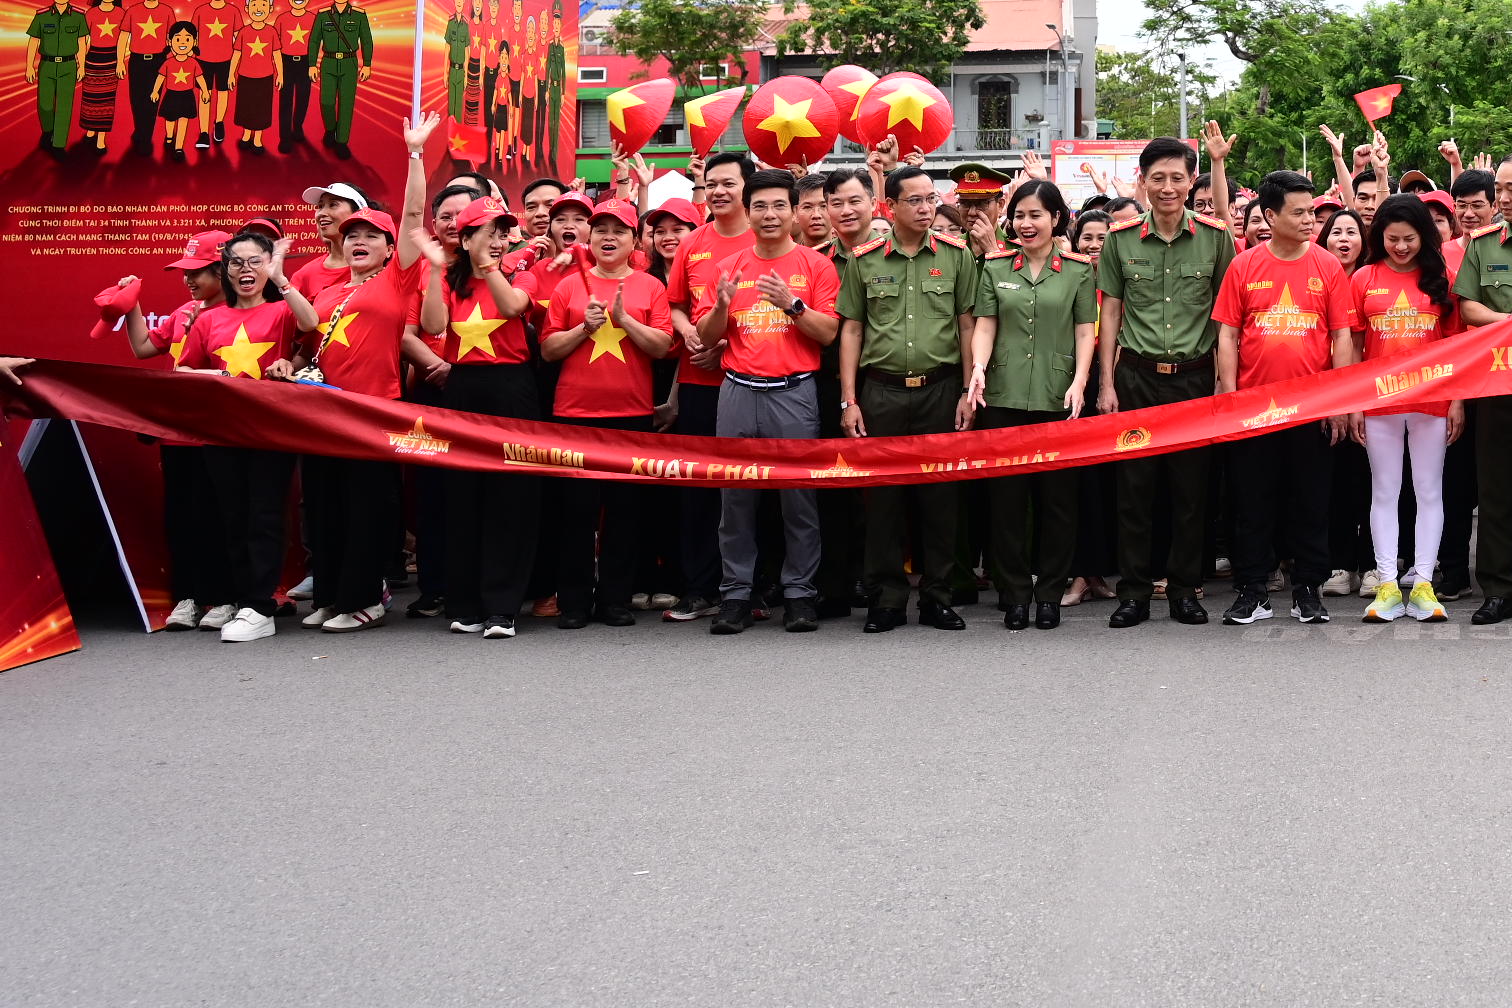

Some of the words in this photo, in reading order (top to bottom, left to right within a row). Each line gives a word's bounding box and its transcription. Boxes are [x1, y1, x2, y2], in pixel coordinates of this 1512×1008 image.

[8, 205, 42, 213] CHƯƠNG
[44, 204, 67, 213] TRÌNH
[126, 203, 148, 212] NHÂN
[151, 203, 167, 212] DÂN
[271, 204, 282, 212] AN
[152, 247, 164, 255] AN
[1287, 314, 1318, 330] NAM
[1404, 316, 1437, 331] NAM
[1375, 372, 1420, 395] Nhân
[1421, 364, 1453, 382] Dân
[420, 441, 449, 453] NAM
[503, 442, 548, 463] Nhân
[550, 447, 585, 467] Dân
[630, 456, 699, 480] XUẤT
[706, 462, 775, 480] PHÁT
